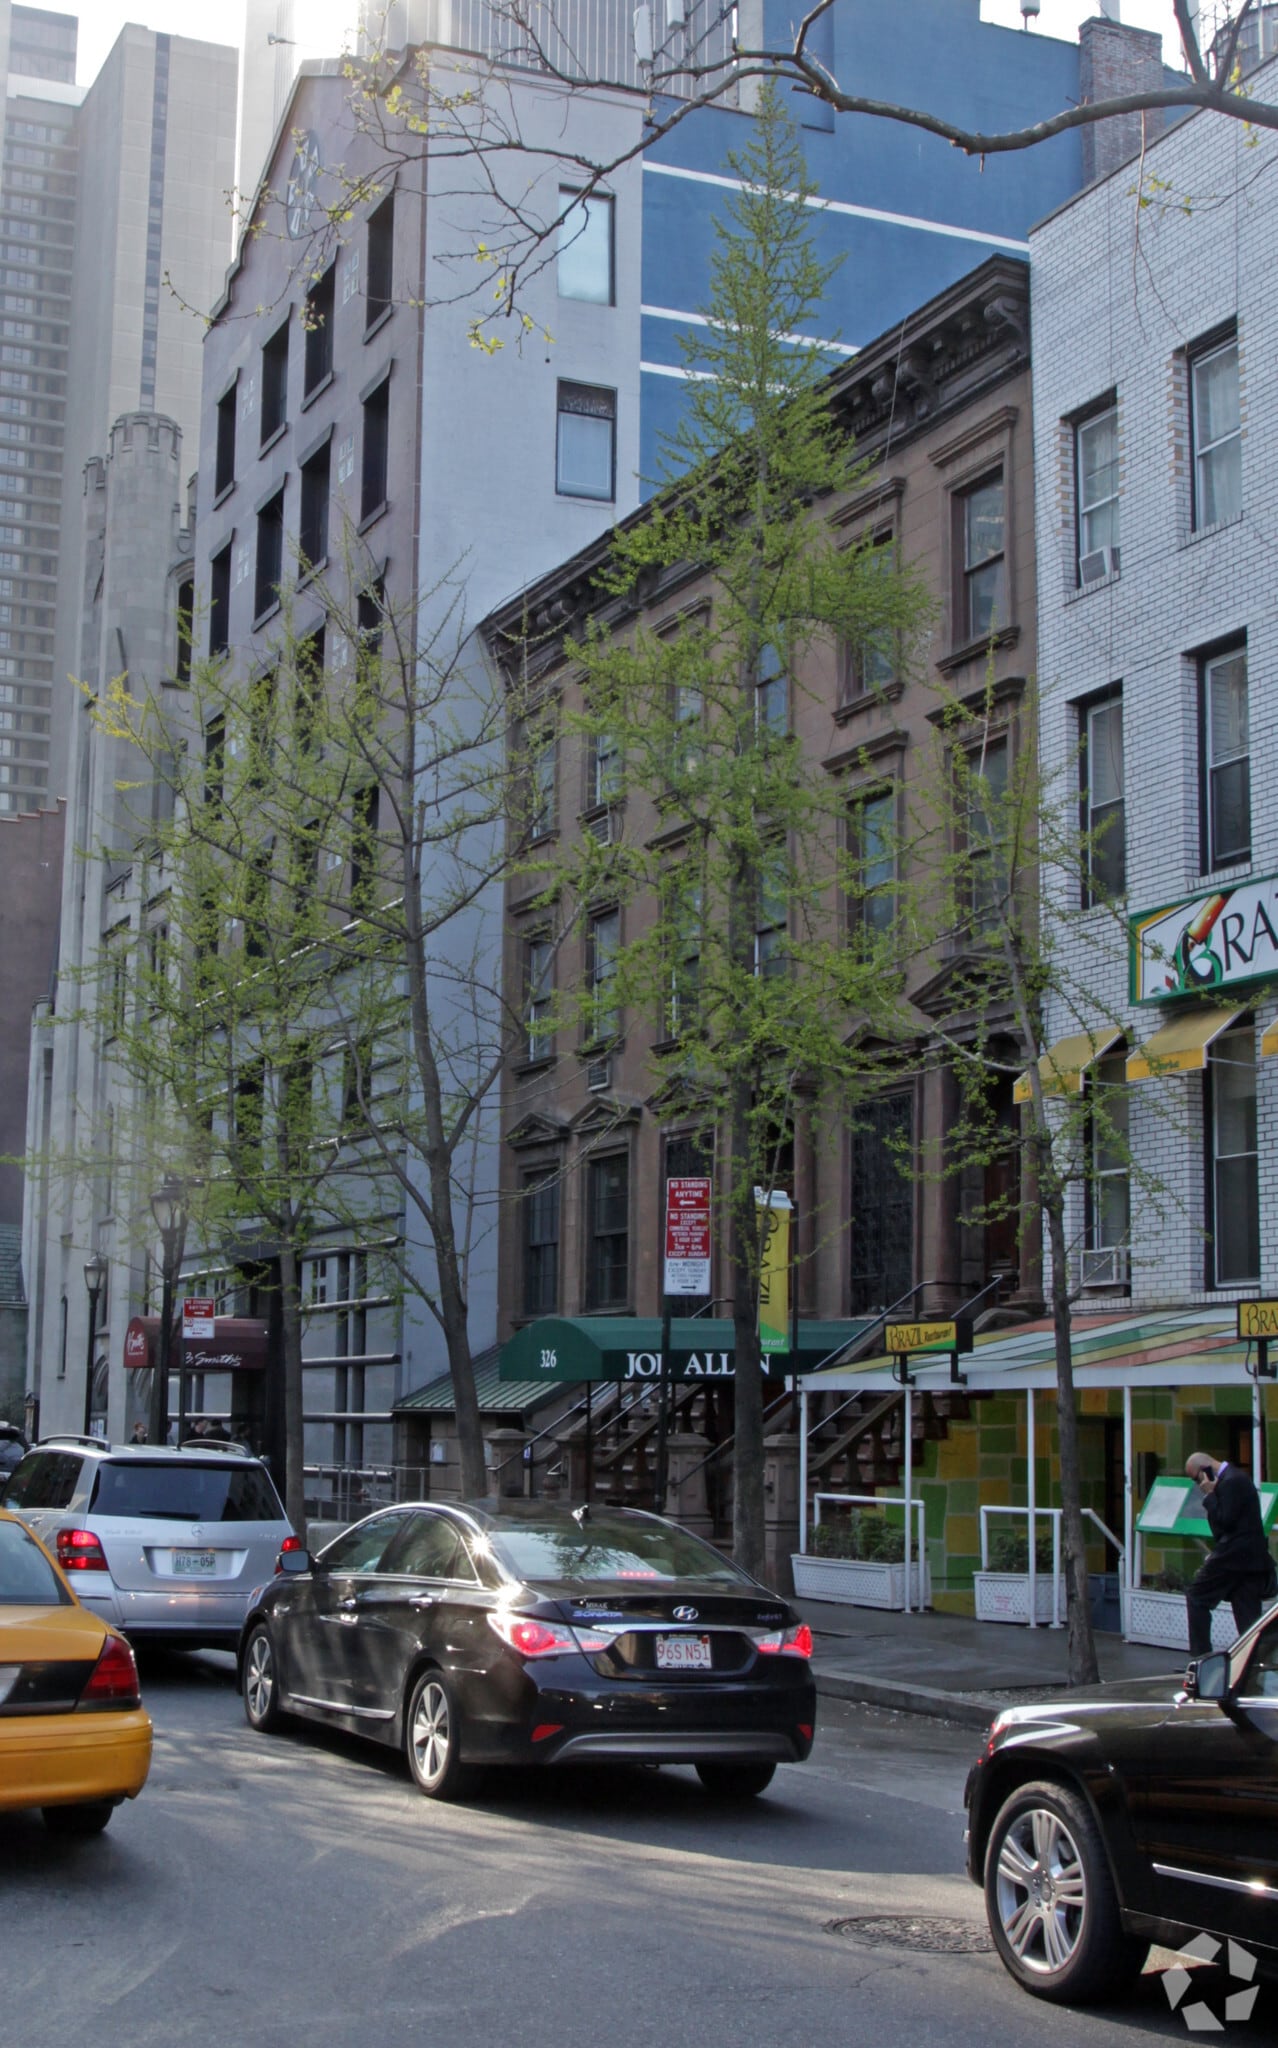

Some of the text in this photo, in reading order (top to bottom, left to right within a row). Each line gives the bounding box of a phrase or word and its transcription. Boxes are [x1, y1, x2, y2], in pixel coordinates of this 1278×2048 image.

[1175, 892, 1278, 990] BRA
[675, 1190, 703, 1198] ANYTIME
[540, 1349, 557, 1368] 326
[683, 1352, 771, 1376] ALLN
